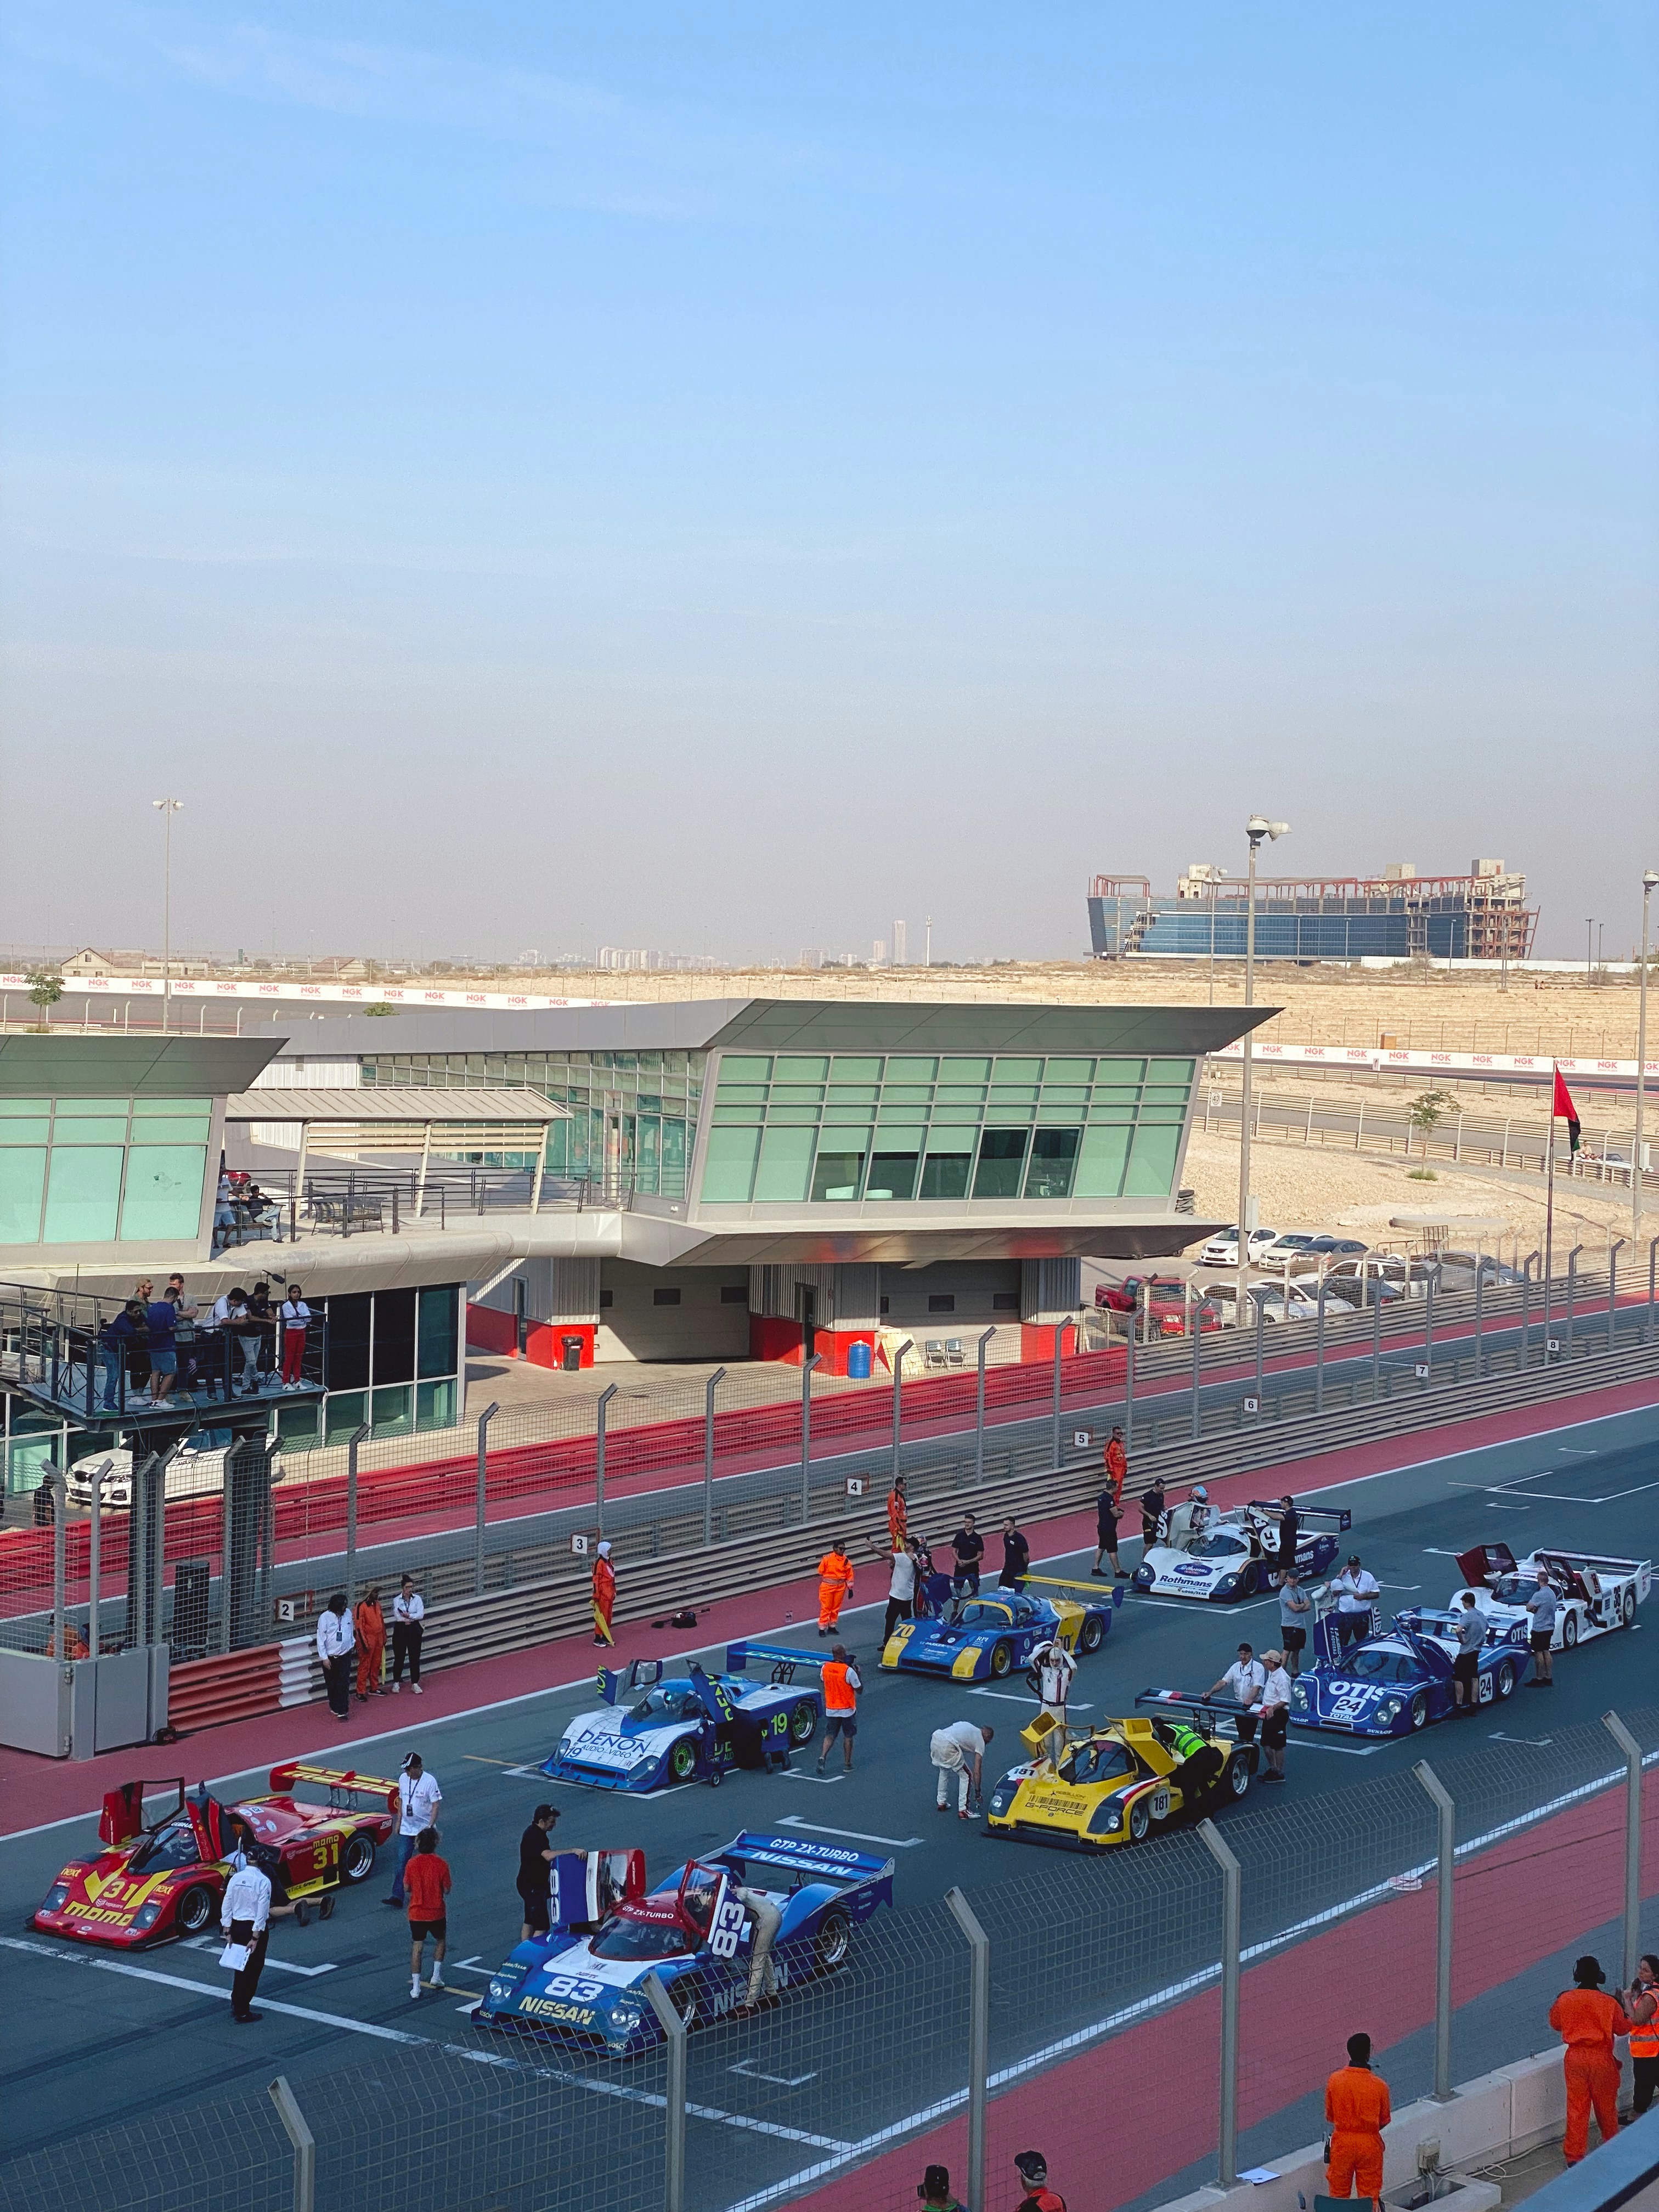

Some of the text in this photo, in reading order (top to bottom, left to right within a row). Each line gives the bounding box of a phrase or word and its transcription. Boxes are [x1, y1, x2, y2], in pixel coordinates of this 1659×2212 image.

[1248, 1400, 1254, 1409] 6
[1079, 1434, 1085, 1443] 5
[850, 1481, 857, 1492] 4
[577, 1538, 583, 1549] 3
[1159, 1575, 1212, 1588] Rothmans
[281, 1604, 290, 1616] 2
[891, 1623, 916, 1638] 70
[1511, 1624, 1527, 1643] OTIS
[744, 1650, 825, 1666] DENON
[1328, 1680, 1387, 1701] OTIS
[1480, 1677, 1492, 1698] 24
[1334, 1699, 1362, 1712] 24
[771, 1712, 788, 1736] 19
[577, 1729, 651, 1754] DENON
[565, 1747, 582, 1758] 19
[582, 1745, 631, 1758] AUDIO VIDEO
[1013, 1768, 1035, 1776] 181
[1025, 1802, 1085, 1816] G-FORCE
[1154, 1793, 1168, 1811] 181
[313, 1843, 339, 1870] 31
[770, 1838, 859, 1862] GTP ZX-TURBO
[751, 1850, 854, 1876] NISSAN
[103, 1880, 138, 1901] 31
[633, 1909, 674, 1920] ZX-TURBO
[712, 1901, 746, 1958] 83
[544, 1976, 604, 2002] 83
[714, 1962, 788, 2017] NISN
[518, 1995, 596, 2025] NISSAN
